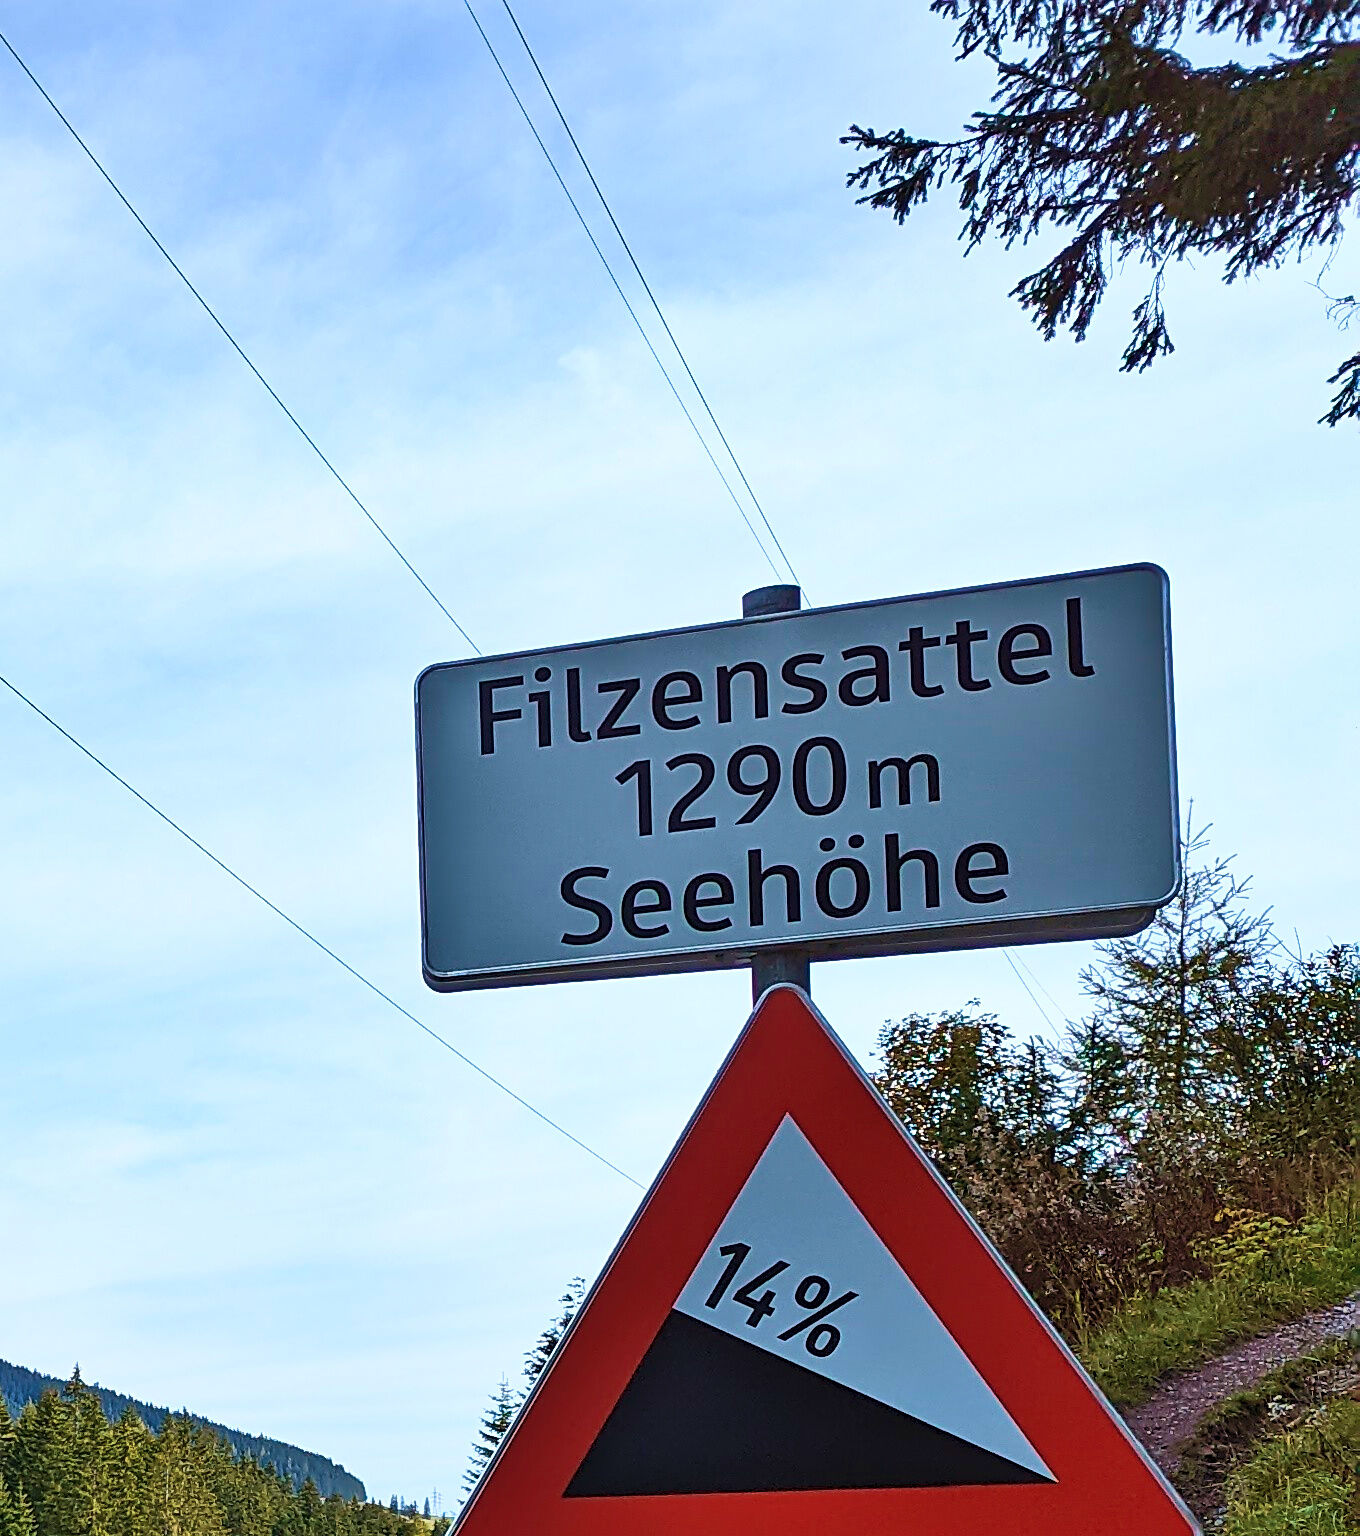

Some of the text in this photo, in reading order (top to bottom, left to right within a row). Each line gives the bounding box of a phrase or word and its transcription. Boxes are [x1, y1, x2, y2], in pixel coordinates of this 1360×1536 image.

[479, 597, 1095, 756] Filzensattel
[559, 833, 1010, 946] Seehöhe
[704, 1242, 860, 1358] 14%
